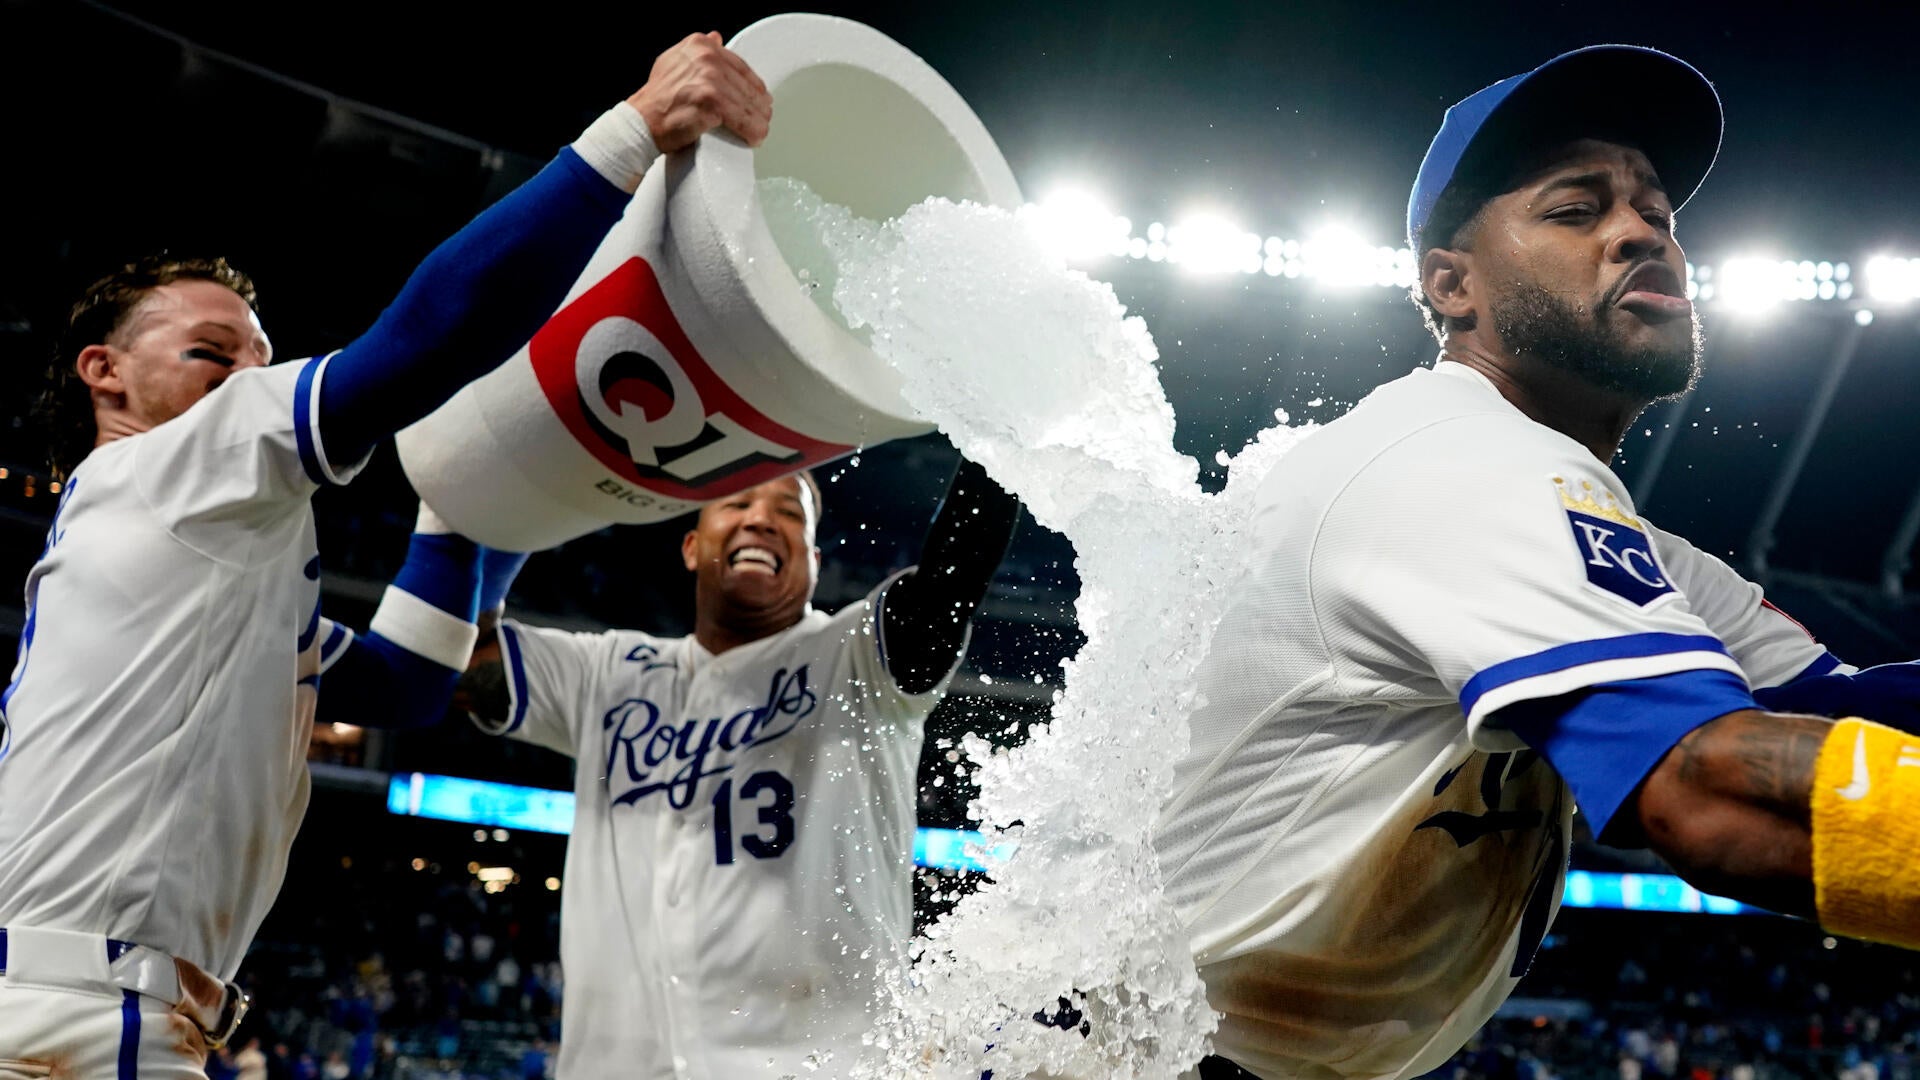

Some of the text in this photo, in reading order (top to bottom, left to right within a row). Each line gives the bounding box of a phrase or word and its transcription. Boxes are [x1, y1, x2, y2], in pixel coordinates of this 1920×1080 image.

[575, 315, 803, 485] QT
[594, 479, 656, 508] BIG
[1574, 520, 1666, 588] KC
[603, 664, 816, 810] Royals
[711, 770, 795, 866] 13
